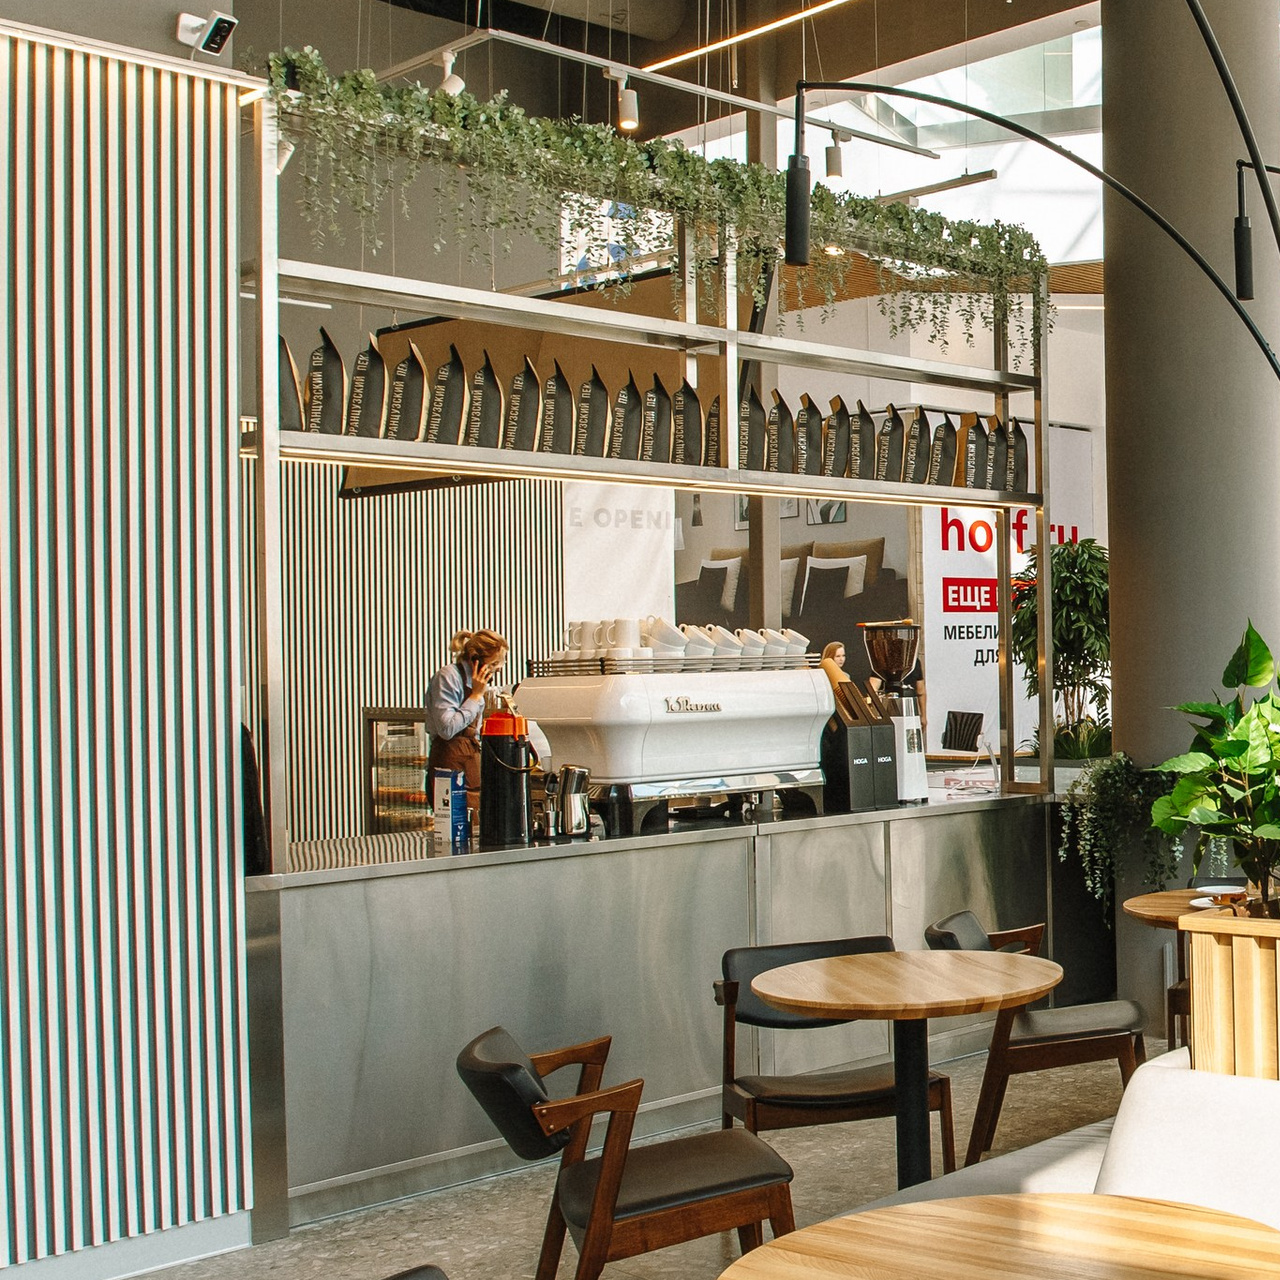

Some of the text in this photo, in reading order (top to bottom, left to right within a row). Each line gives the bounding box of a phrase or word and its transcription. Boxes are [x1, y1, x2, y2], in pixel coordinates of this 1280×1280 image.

[543, 398, 555, 452] РАНЦУЗСКИЙ
[577, 402, 590, 455] РАНЦУЗСКИЙ
[611, 407, 626, 458] РАНЦУЗСКИЙ
[643, 410, 655, 461] РАНЦУЗСКИЙ
[676, 414, 684, 464] РАНЦУЗСКИЙ
[708, 418, 718, 466] РАНЦУЗСКИЙ
[739, 420, 749, 469] РАНЦУЗСКИЙ
[769, 424, 778, 472] РАНЦУЗСКИЙ
[798, 427, 807, 476] РАНЦУЗСКИЙ
[851, 434, 860, 478] РАНЦУЗСКИЙ
[877, 435, 890, 480] РАНЦУЗСКИЙ
[905, 438, 917, 482] РАНЦУЗСКИЙ
[930, 440, 943, 486] РАНЦУЗСКИЙ
[966, 443, 976, 489] РАНЦУЗСКИЙ
[941, 507, 1077, 553] hofu
[948, 586, 991, 610] ЕЩЕ
